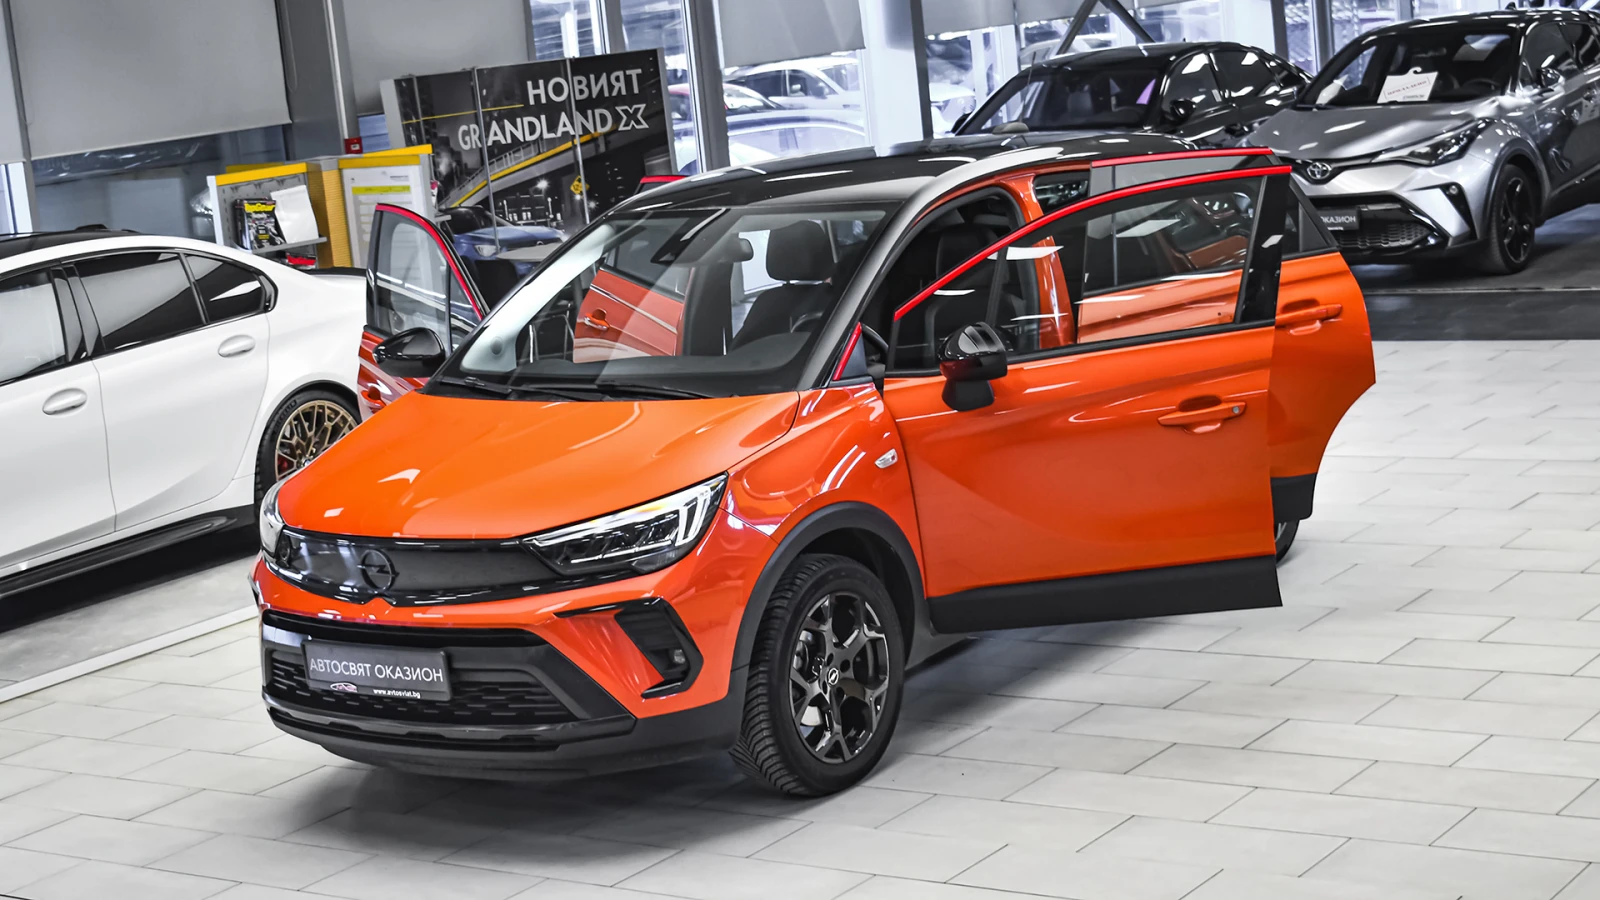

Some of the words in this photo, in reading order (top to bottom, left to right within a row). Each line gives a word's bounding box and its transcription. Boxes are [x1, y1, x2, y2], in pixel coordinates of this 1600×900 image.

[527, 69, 642, 106] НОВИЯТ
[458, 108, 612, 150] GRANDLAND
[310, 658, 371, 677] АВТОСВЯТ
[374, 664, 444, 682] ОКАЗИОН
